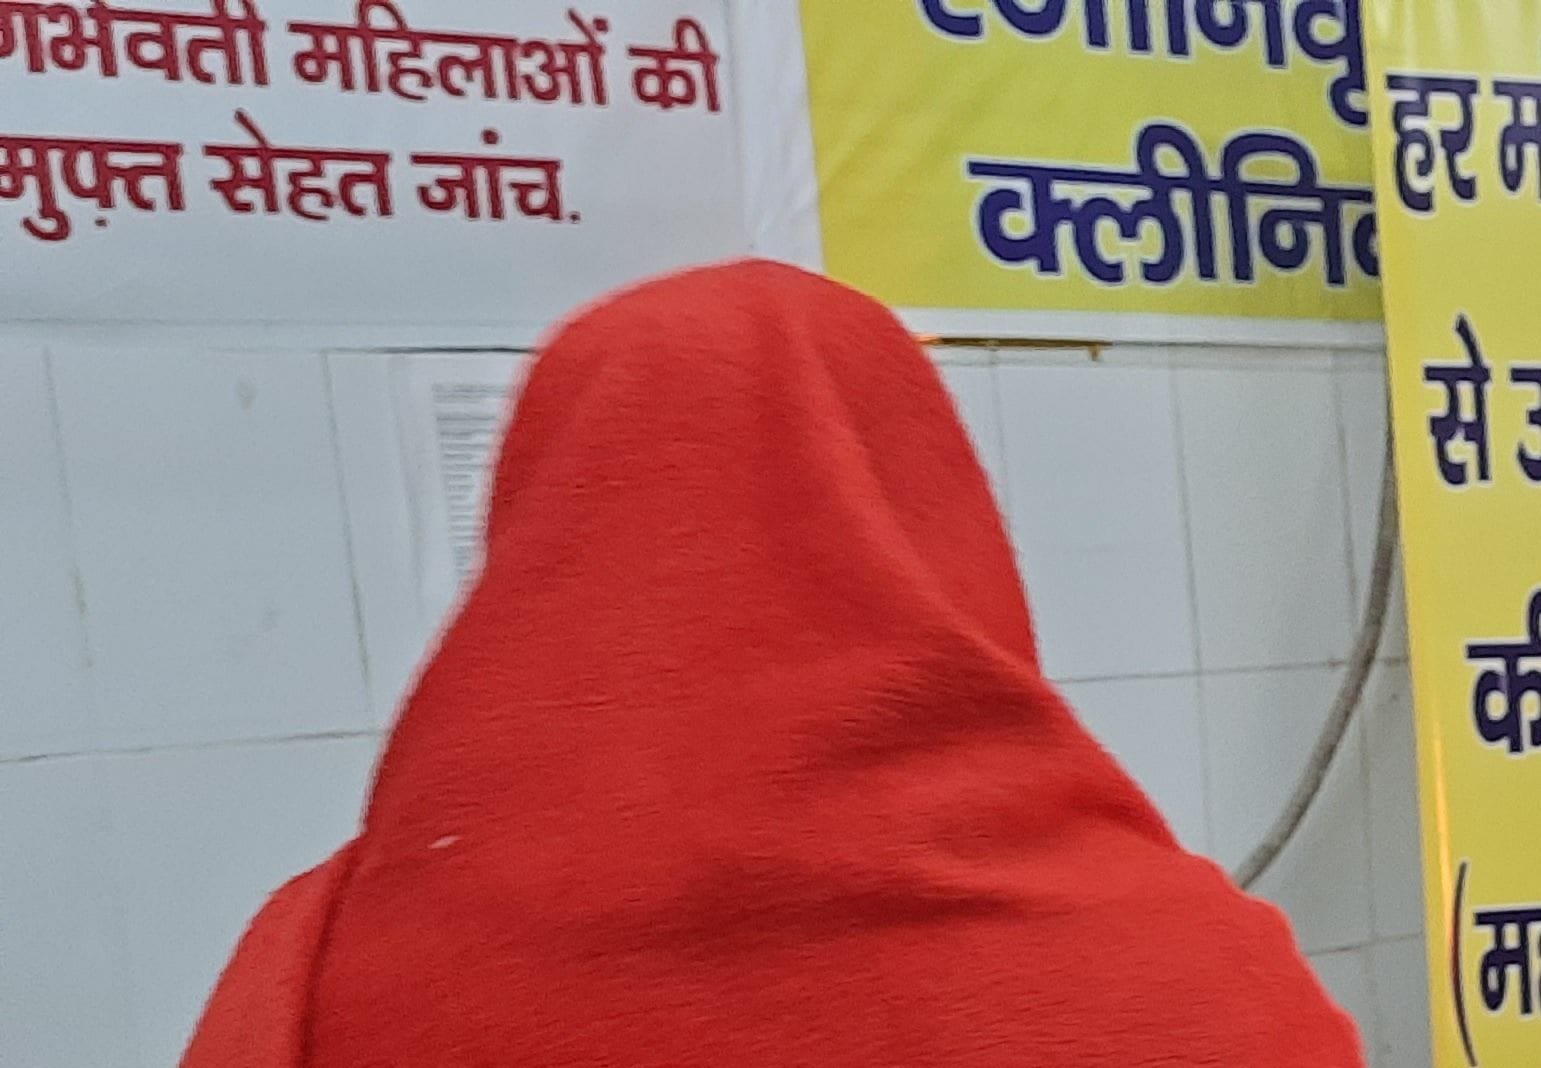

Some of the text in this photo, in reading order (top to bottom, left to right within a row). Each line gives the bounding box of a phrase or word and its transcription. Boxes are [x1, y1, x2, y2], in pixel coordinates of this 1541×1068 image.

[290, 0, 607, 103] महिलाओं
[631, 19, 719, 111] की
[207, 116, 390, 214] सेहत
[412, 130, 582, 222] जांच.
[1386, 75, 1477, 212] हर
[1424, 316, 1491, 485] से
